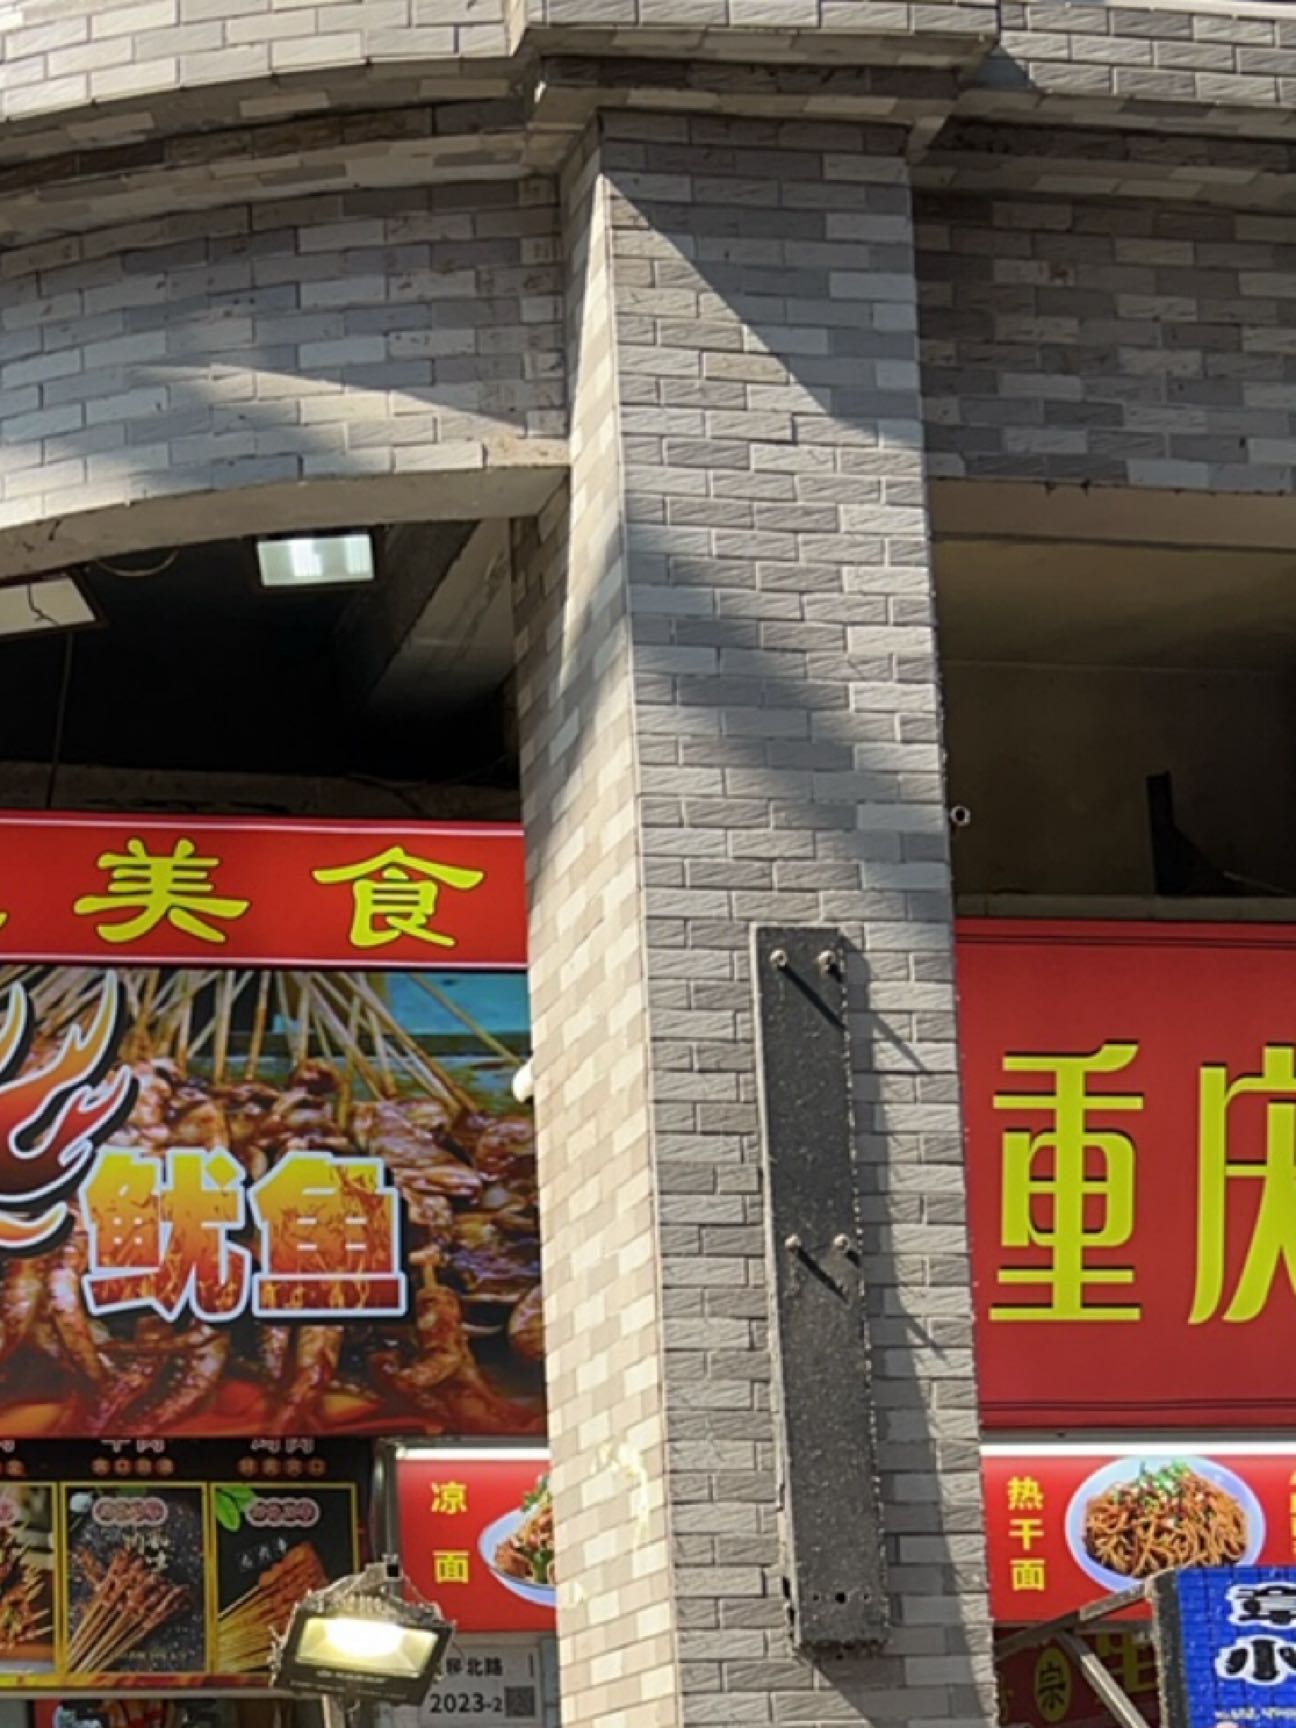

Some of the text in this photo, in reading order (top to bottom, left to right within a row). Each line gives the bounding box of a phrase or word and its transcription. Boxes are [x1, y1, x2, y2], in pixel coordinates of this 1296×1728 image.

[989, 1042, 1296, 1324] 重庆
[431, 1481, 470, 1584] 凉面
[1007, 1476, 1046, 1591] 热干面
[430, 1691, 503, 1714] 2023-2
[434, 1656, 503, 1677] 民北路
